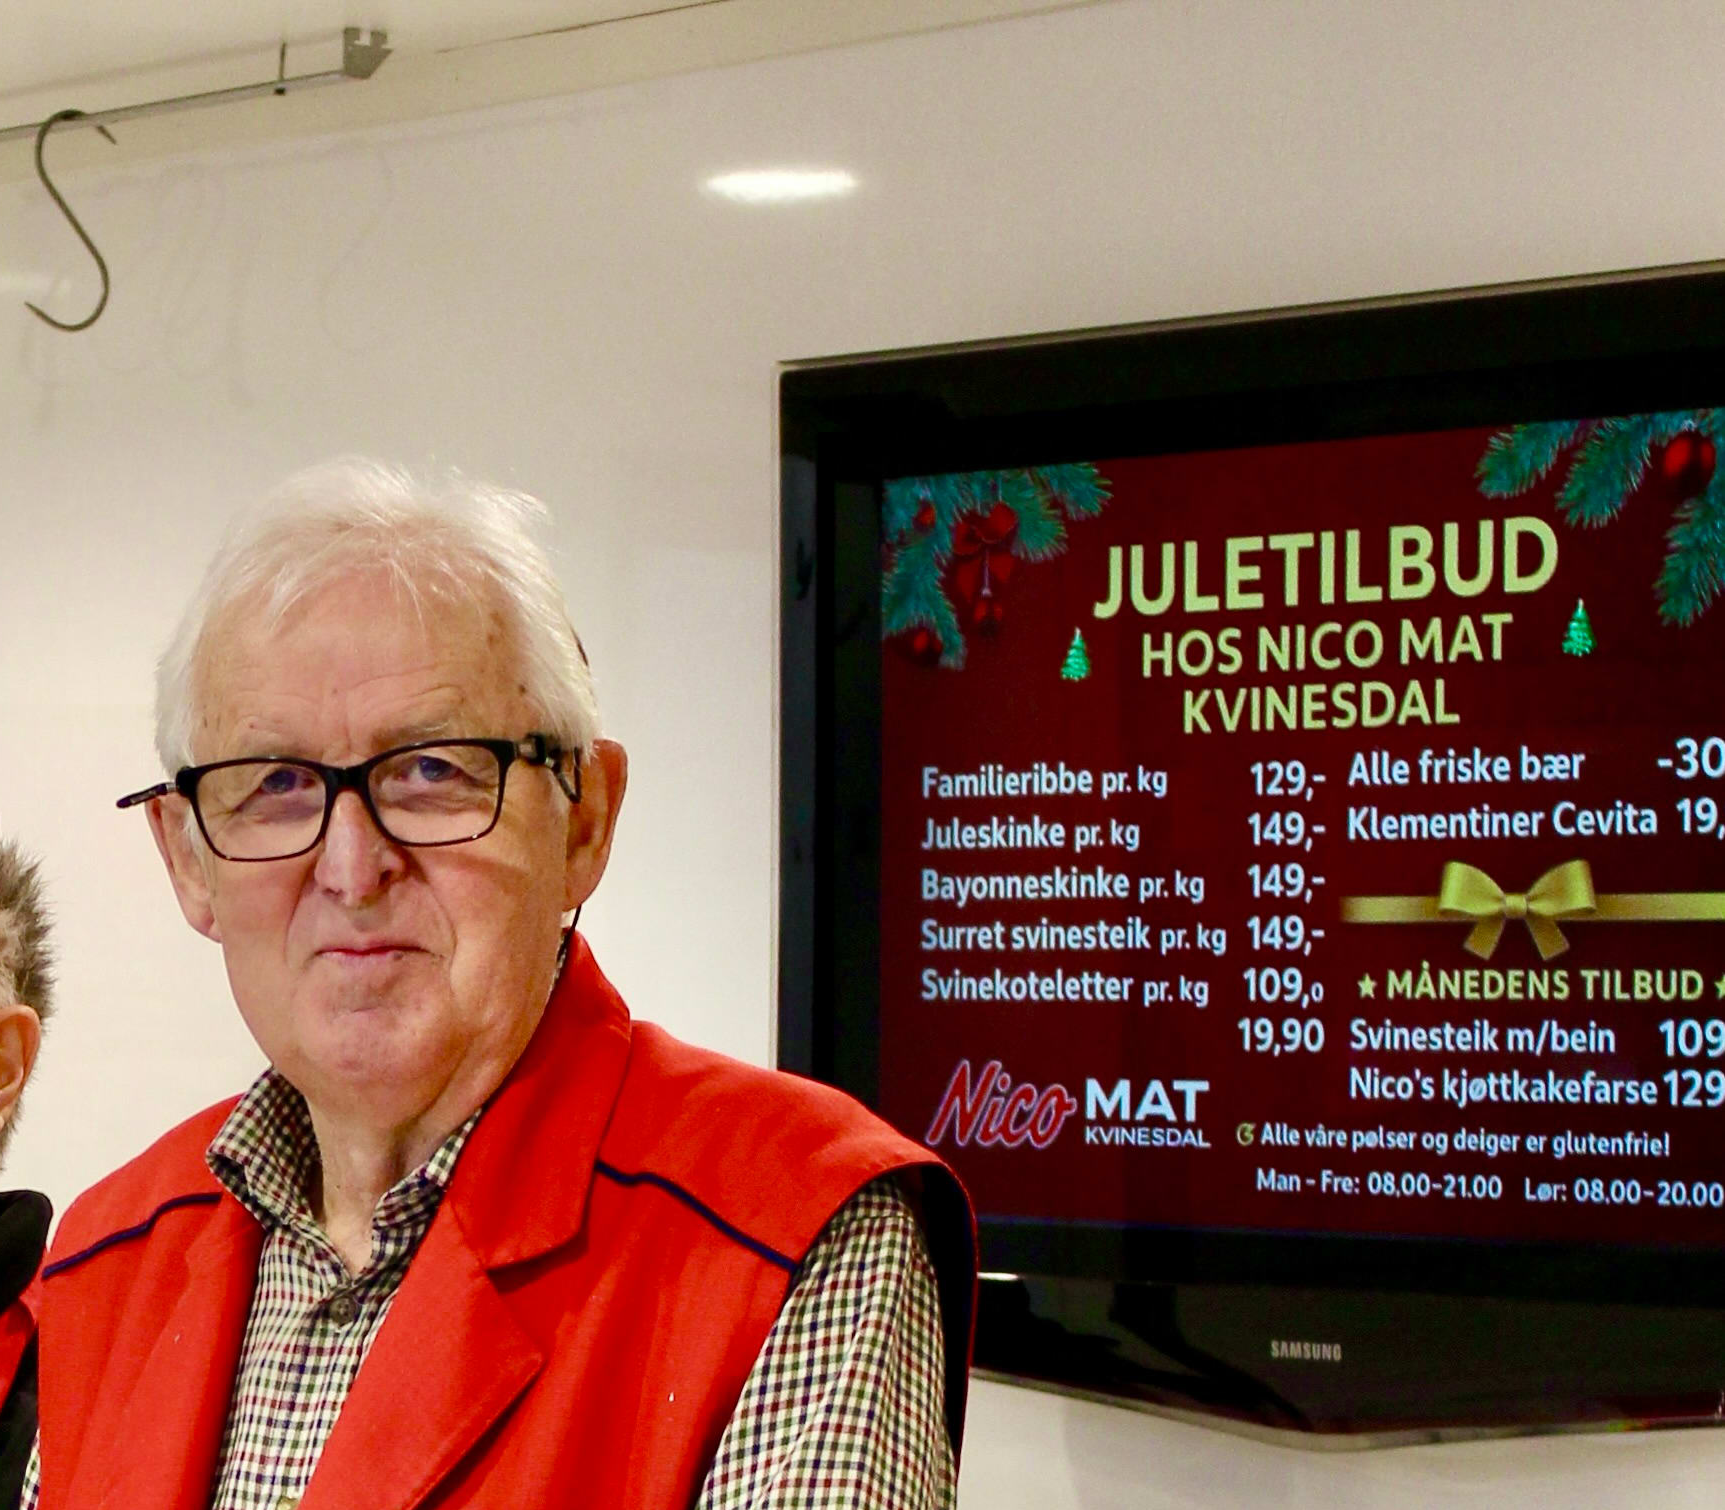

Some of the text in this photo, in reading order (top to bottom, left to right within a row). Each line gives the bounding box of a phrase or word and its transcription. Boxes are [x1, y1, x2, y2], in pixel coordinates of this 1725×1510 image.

[1093, 516, 1559, 619] JULETILBUD
[1142, 613, 1514, 678] HOS NICO MAT
[1183, 678, 1461, 734] KVINESDAL
[921, 760, 1326, 802] Familieribbe pr. kg 129,-
[1348, 751, 1410, 786] Alle
[1419, 746, 1511, 784] friske
[1520, 745, 1585, 780] bær
[921, 811, 1326, 853] Juleskinke pr. kg 149,-
[1347, 806, 1545, 841] Klementiner
[1552, 800, 1657, 836] Cevita
[921, 863, 1325, 908] Bayonneskinke pr. kg 149,-
[920, 915, 1325, 956] Surret svinesteik pr. kg 149,-
[920, 967, 1134, 1001] Svinekoteletter
[1143, 980, 1173, 1007] pr.
[1180, 975, 1209, 1008] kg
[1387, 961, 1704, 1001] MÅNEDENS TILBUD
[1238, 1017, 1325, 1056] 19,90
[1349, 1018, 1725, 1057] Svinesteik m/bein 109
[925, 1059, 1077, 1148] Nico
[1085, 1078, 1210, 1122] MAT
[1349, 1066, 1725, 1109] Nico's kjøttkakefarse 129
[1085, 1126, 1211, 1148] KVINESDAL
[1260, 1121, 1300, 1146] Alle
[1304, 1123, 1347, 1147] våre
[1352, 1124, 1417, 1153] pølser
[1422, 1132, 1448, 1156] og
[1453, 1127, 1520, 1158] deiger
[1526, 1135, 1547, 1153] er
[1256, 1167, 1301, 1192] Man
[1321, 1169, 1360, 1195] Fre:
[1524, 1176, 1567, 1201] Lør:
[1271, 1340, 1342, 1361] SAMSUNG
